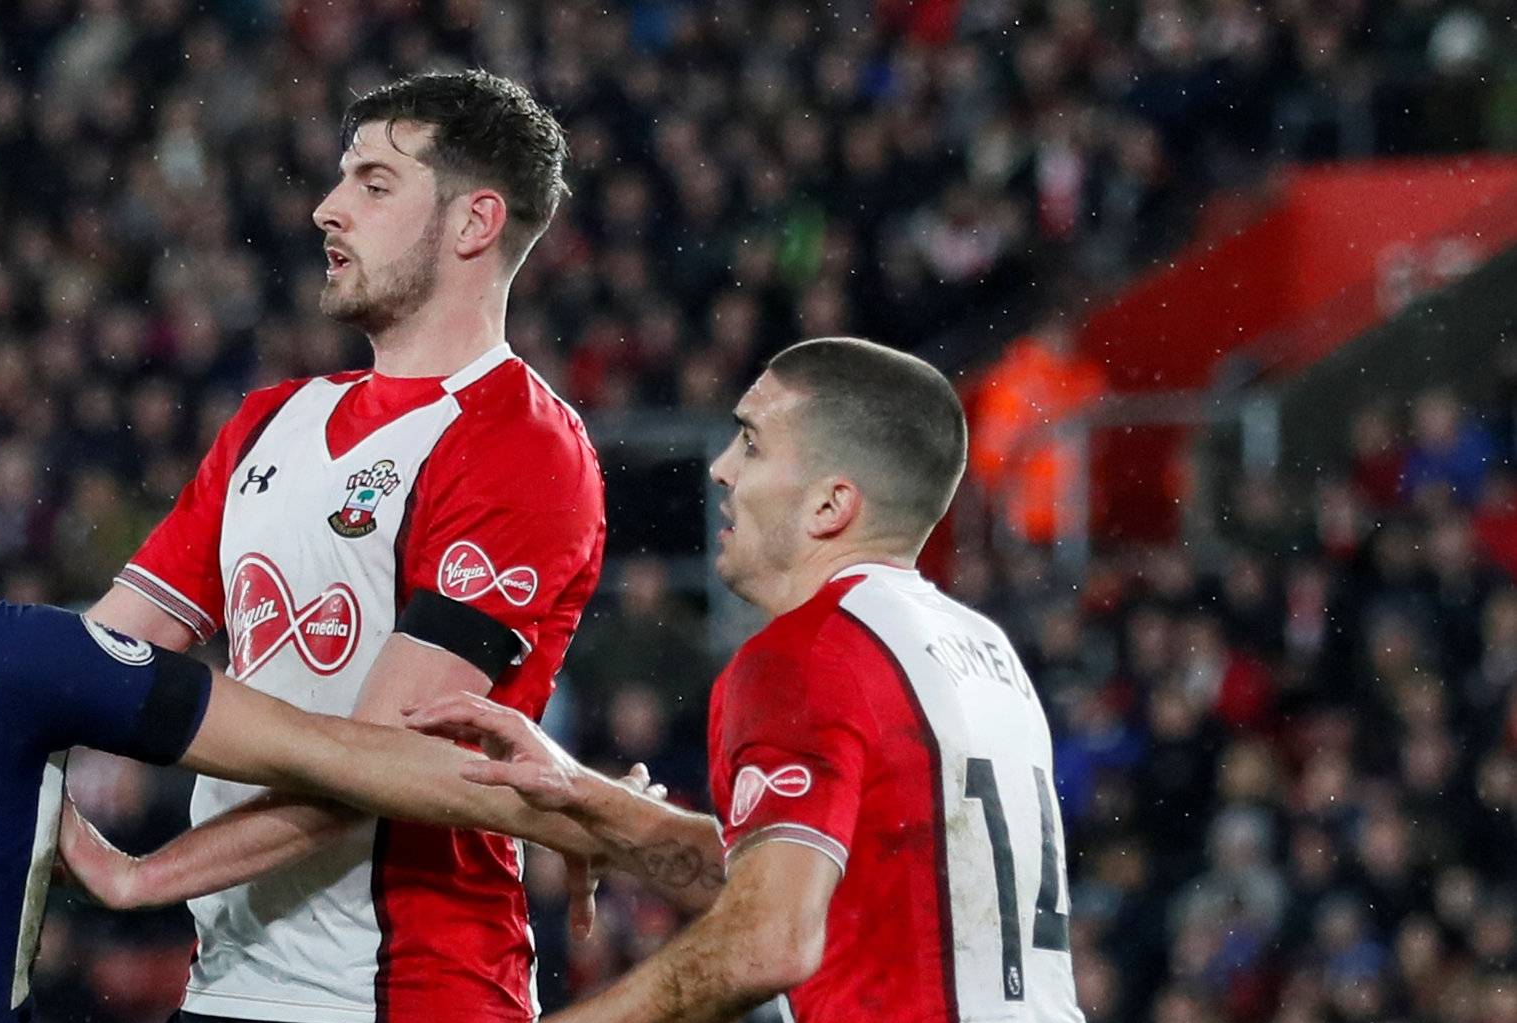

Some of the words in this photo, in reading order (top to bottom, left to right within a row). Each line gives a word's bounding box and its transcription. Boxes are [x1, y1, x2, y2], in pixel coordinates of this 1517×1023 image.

[445, 552, 488, 593] Virgin
[502, 578, 533, 593] media
[305, 617, 349, 638] media
